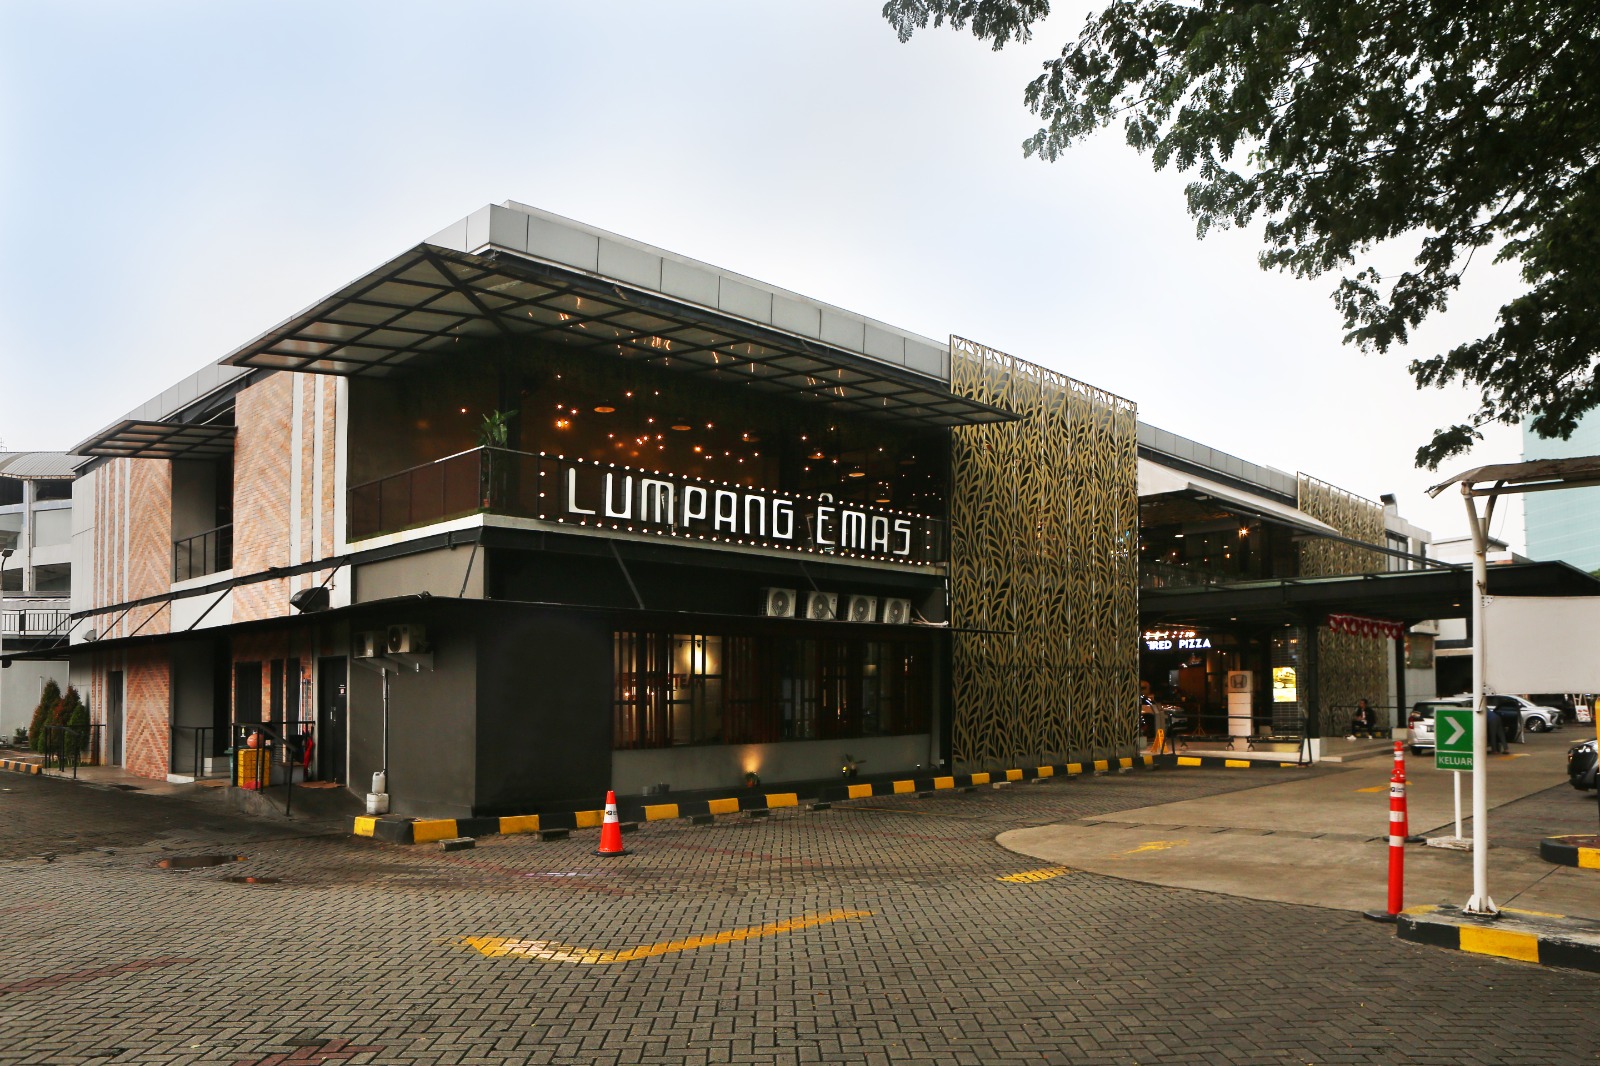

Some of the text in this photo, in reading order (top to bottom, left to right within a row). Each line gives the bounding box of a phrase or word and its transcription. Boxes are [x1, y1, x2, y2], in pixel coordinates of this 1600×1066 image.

[568, 467, 794, 540] LUMPANG
[1179, 638, 1212, 649] PIZZA
[1438, 756, 1473, 766] KELUAR
